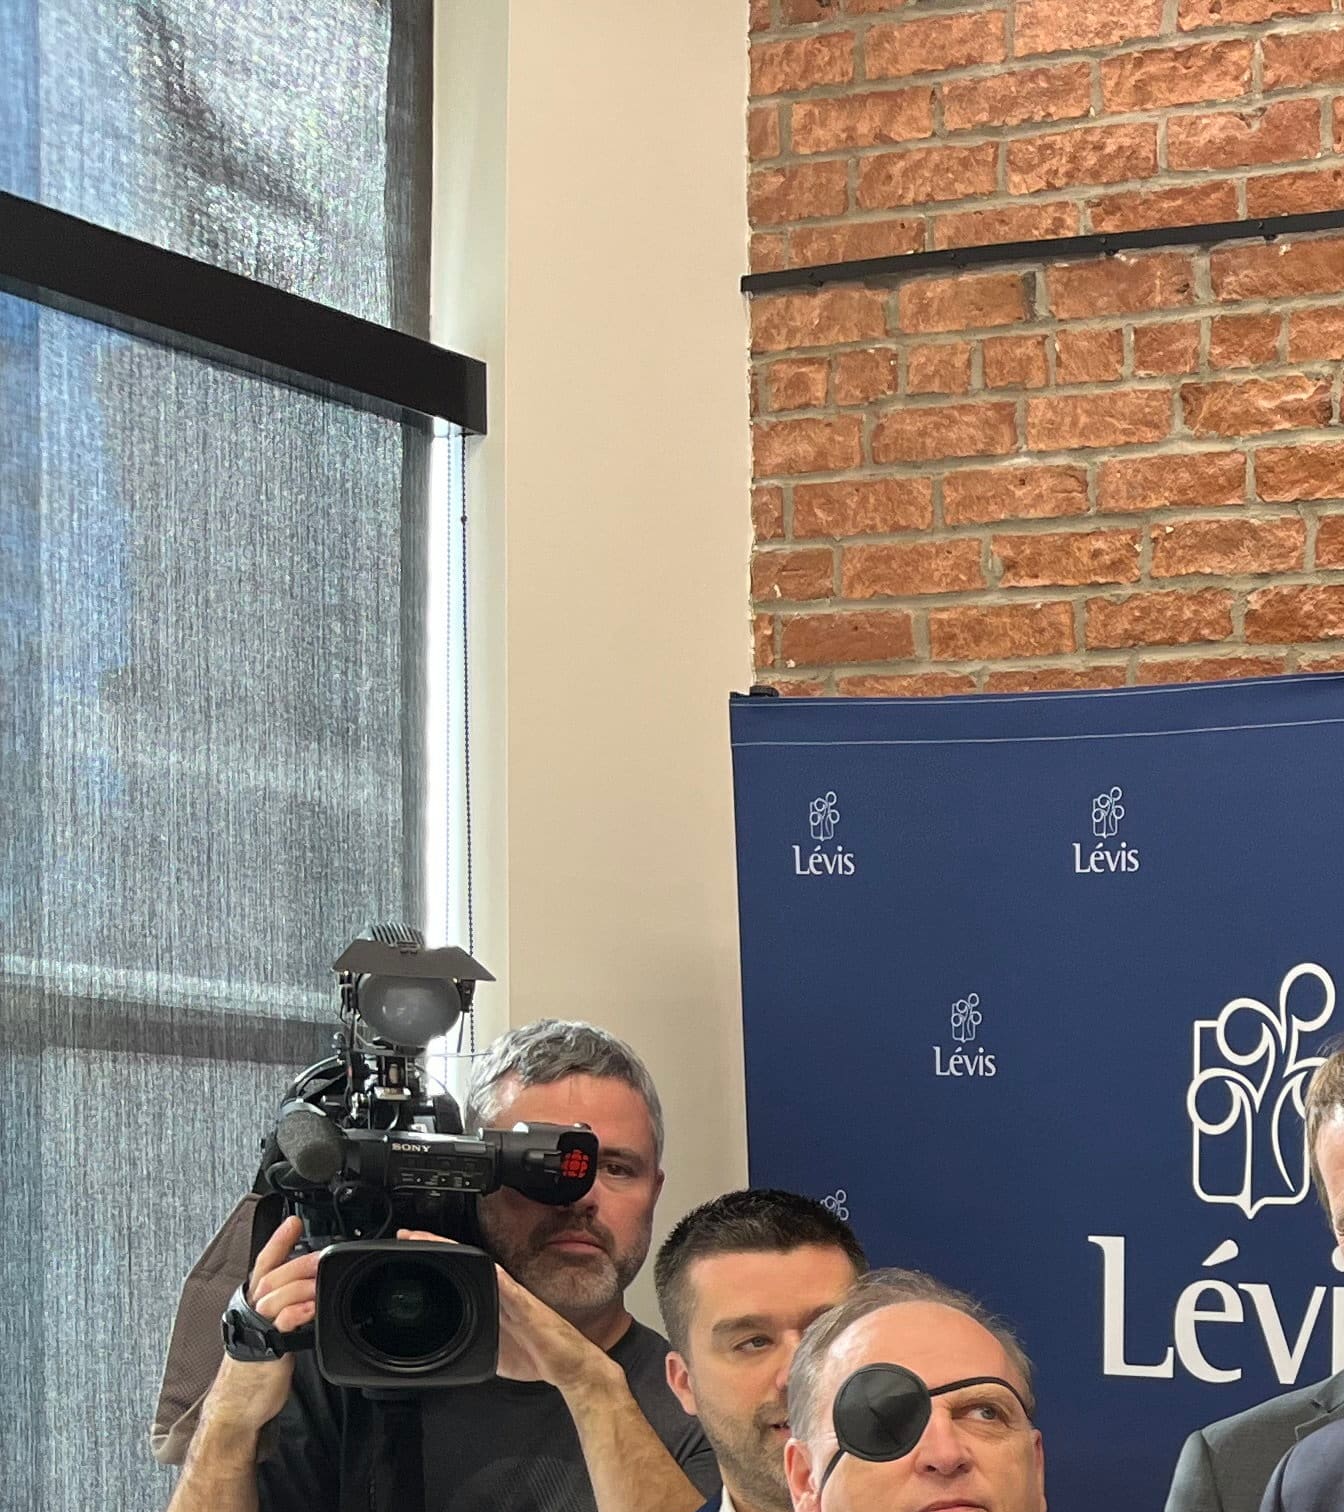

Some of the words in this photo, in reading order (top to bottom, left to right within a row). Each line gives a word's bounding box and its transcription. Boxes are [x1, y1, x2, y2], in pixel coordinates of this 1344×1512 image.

[793, 845, 855, 877] Lévis
[1072, 842, 1140, 874] Lévis
[932, 1045, 997, 1078] Lévis
[391, 1143, 431, 1153] SONY
